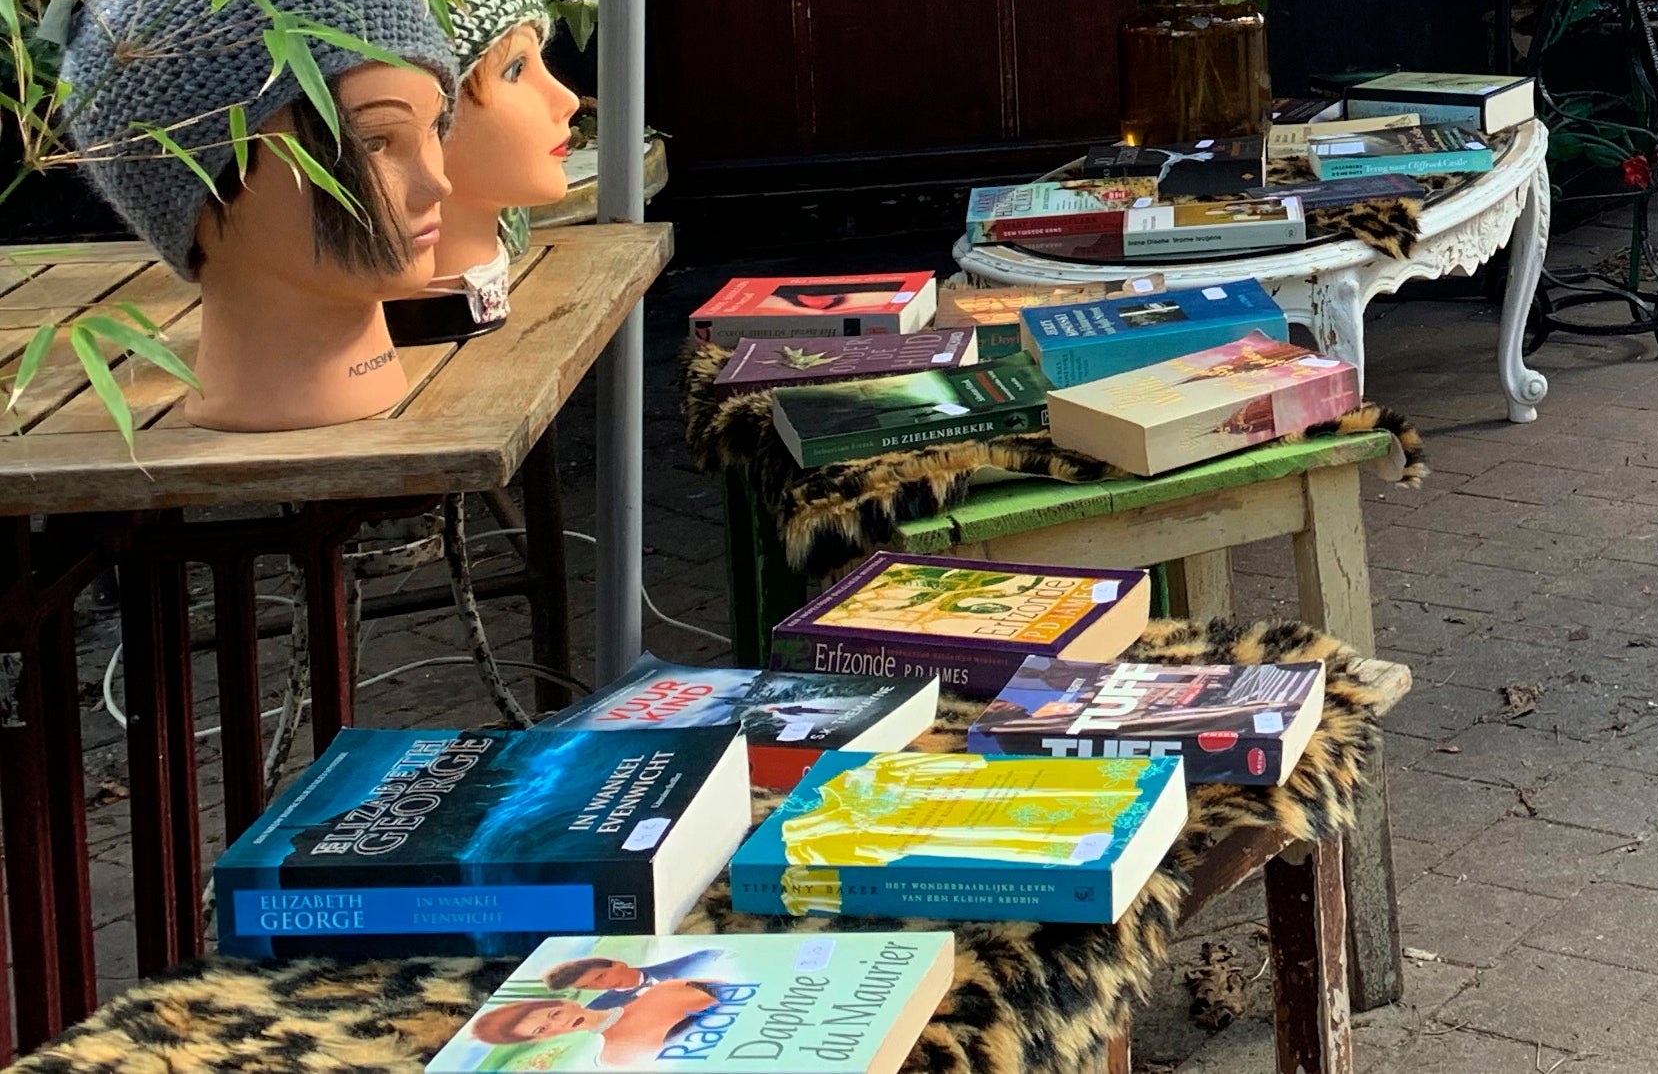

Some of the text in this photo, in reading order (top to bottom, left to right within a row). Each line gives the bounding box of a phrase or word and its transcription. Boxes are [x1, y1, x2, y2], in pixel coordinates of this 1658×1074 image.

[882, 421, 994, 448] DE ZIELENBREKER
[973, 580, 1075, 636] Erfzonde
[814, 642, 896, 678] Erfzonde
[928, 666, 969, 685] JAMES
[595, 679, 689, 722] VUUR
[644, 684, 714, 722] KIND
[1066, 663, 1159, 735] TUFF
[310, 739, 449, 855] ELIZABETH
[354, 738, 493, 855] GEORGE
[568, 808, 598, 832] IN
[588, 755, 645, 809] WANKEL
[596, 750, 676, 835] EVENWICHT
[260, 894, 363, 910] ELIZABETH
[416, 895, 498, 907] IN WANKEL
[742, 883, 879, 895] TIFFANY BAKER
[885, 882, 908, 891] HET
[1020, 883, 1055, 893] LEVEN
[902, 894, 923, 903] VAN
[926, 895, 948, 904] EEN
[953, 895, 993, 904] KLEINE
[260, 911, 365, 931] GEORGE
[413, 912, 505, 924] EVENWICHT
[725, 975, 831, 1061] Daphne
[799, 940, 918, 1062] du Maurier
[656, 982, 761, 1061] Rachel
